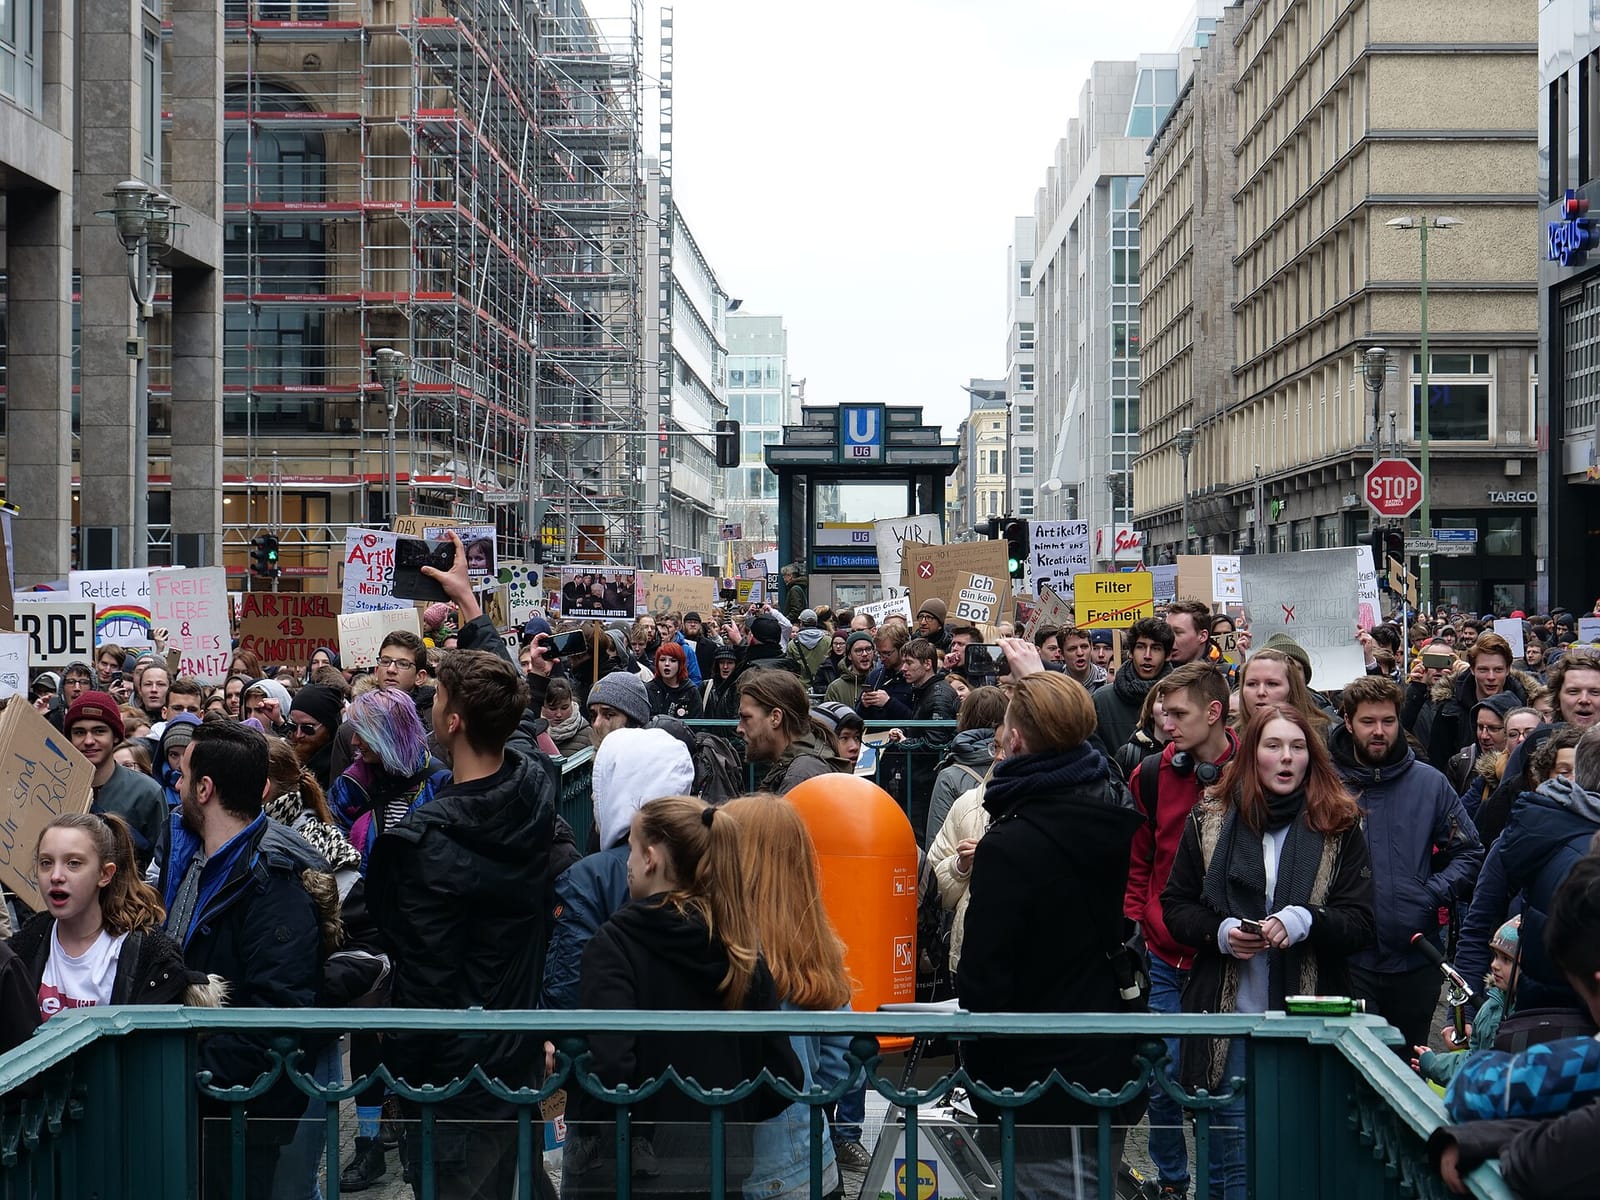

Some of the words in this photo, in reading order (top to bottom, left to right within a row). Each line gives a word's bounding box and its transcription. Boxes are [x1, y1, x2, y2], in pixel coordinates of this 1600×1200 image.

[1548, 218, 1581, 266] Regus
[849, 410, 875, 442] U
[855, 448, 869, 456] U6
[1371, 476, 1418, 499] STOP
[1488, 491, 1537, 503] TARGO
[853, 532, 868, 541] U6
[892, 524, 925, 543] WIR
[663, 559, 685, 571] NEIN
[843, 555, 878, 565] Stadtmitt
[1038, 554, 1086, 567] Kreativität
[80, 580, 127, 598] Rettet
[360, 583, 380, 595] Nein
[970, 575, 992, 590] Ich
[1095, 581, 1132, 593] Filter
[961, 590, 975, 599] Bin
[977, 593, 995, 603] kein
[155, 600, 213, 620] LIEBE
[242, 594, 336, 618] ARTIKEL
[957, 602, 988, 621] Bot
[1087, 608, 1141, 622] Freiheit
[180, 621, 191, 636] &
[277, 617, 304, 636] 13
[14, 614, 87, 661] R.DE
[167, 635, 219, 650] REIES
[181, 652, 228, 677] ERNETZ
[896, 943, 912, 966] BSR
[899, 1176, 934, 1186] LDL
